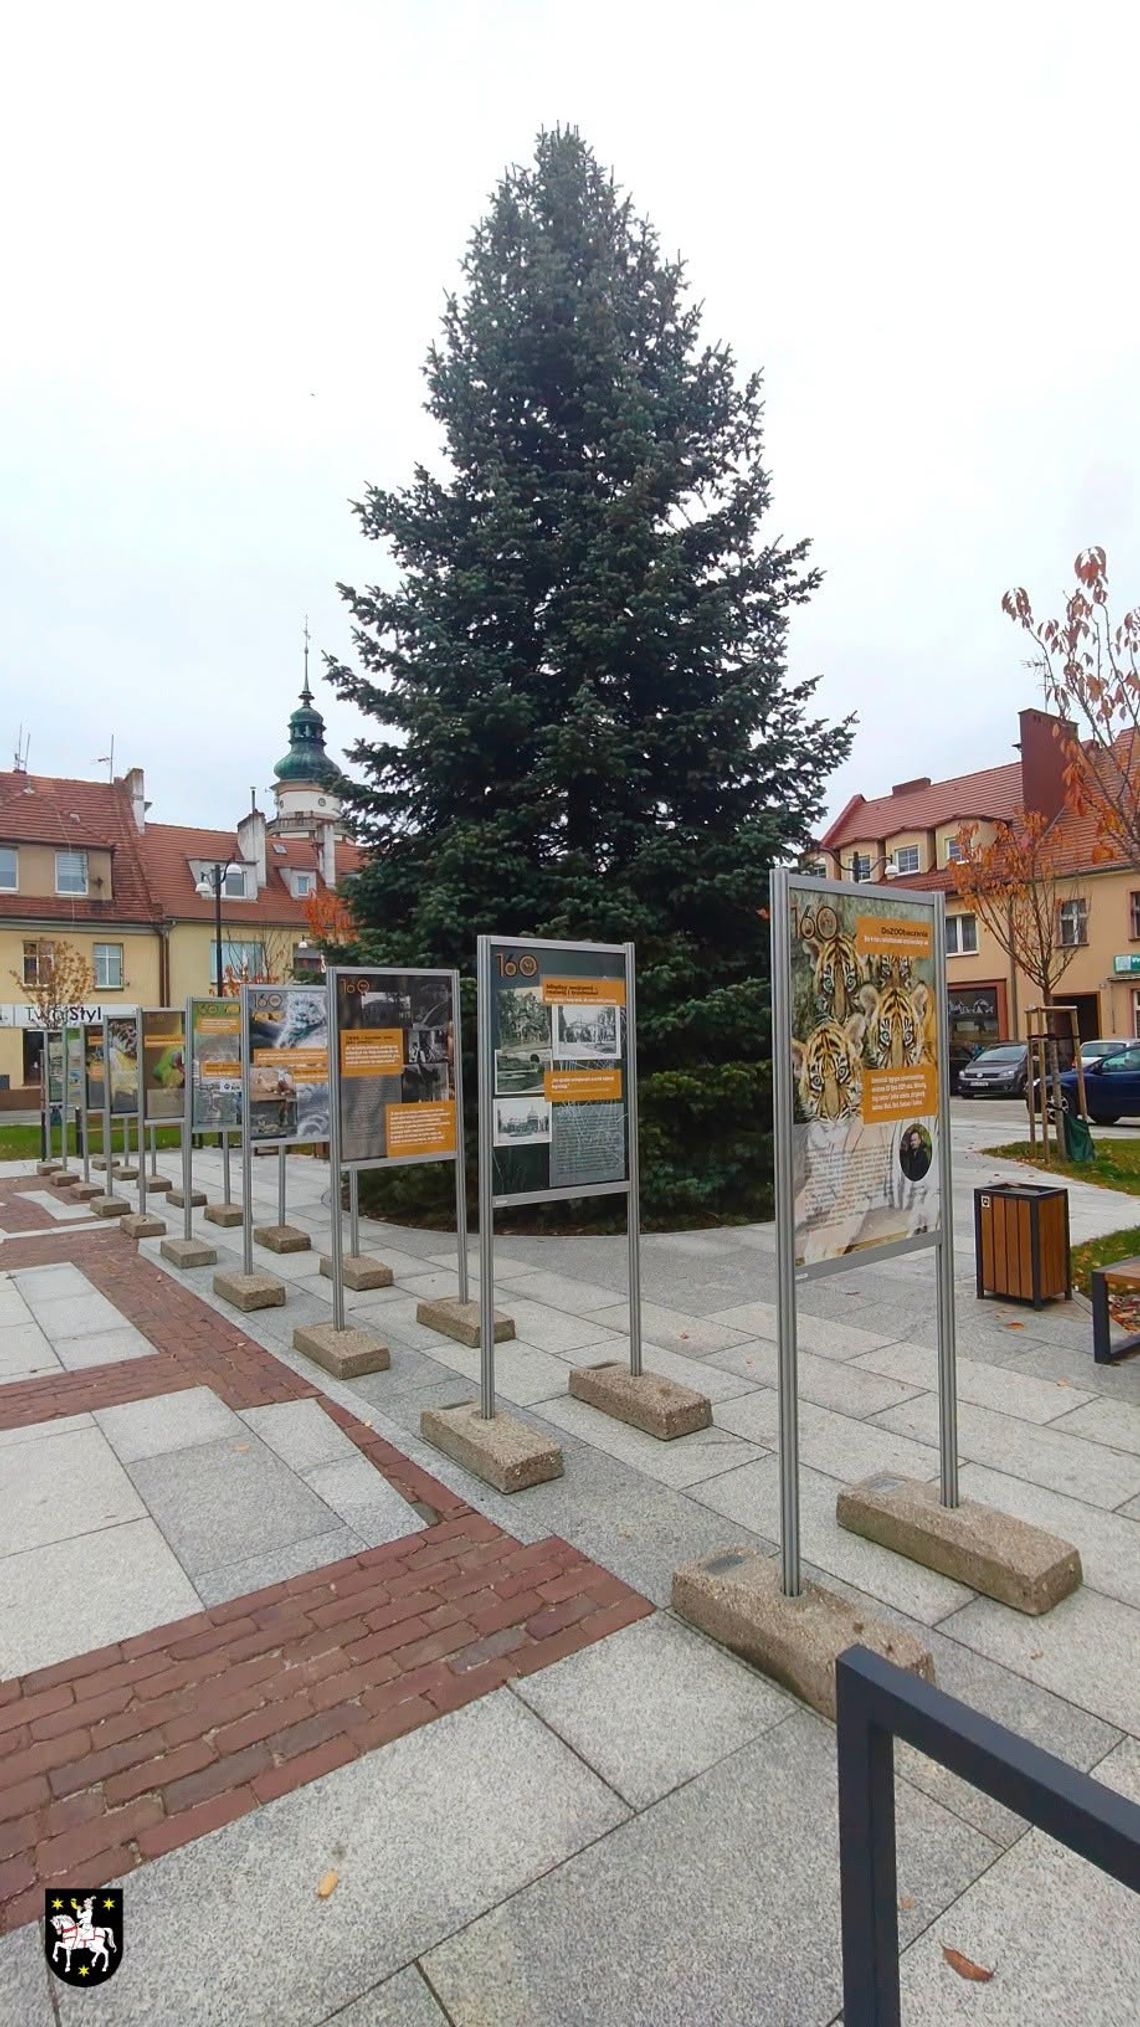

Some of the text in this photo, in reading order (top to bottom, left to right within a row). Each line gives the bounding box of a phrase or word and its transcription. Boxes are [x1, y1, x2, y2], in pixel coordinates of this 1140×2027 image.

[790, 904, 838, 940] 160
[496, 953, 538, 977] 160
[254, 994, 282, 1008] 160
